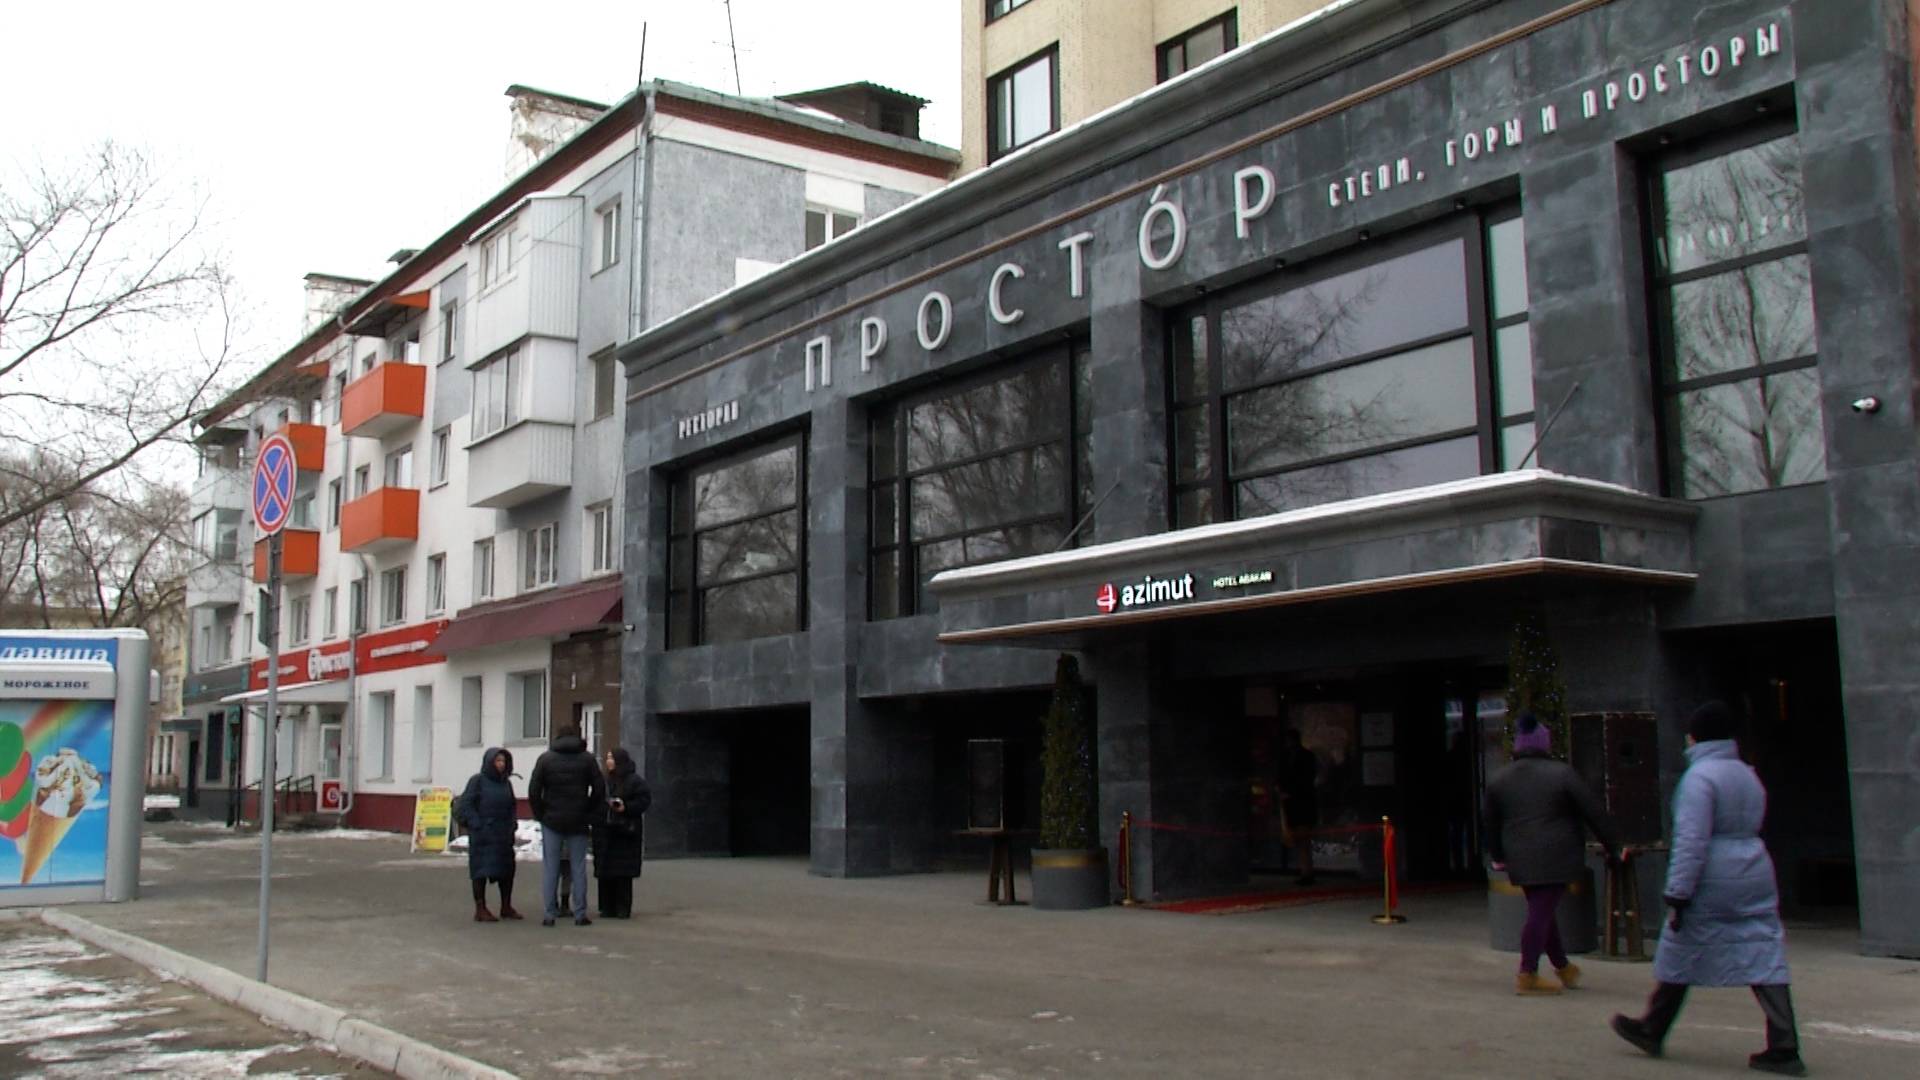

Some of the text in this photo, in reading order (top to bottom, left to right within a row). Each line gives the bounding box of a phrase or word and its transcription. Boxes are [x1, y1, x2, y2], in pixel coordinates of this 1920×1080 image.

[1328, 22, 1781, 208] СТЕПИ, ГОРЫ И ПРОСТОРЫ
[678, 399, 739, 440] РЕСТОРАН
[1121, 572, 1195, 607] azimut
[3, 680, 90, 690] МОРОЖЕНОЕ
